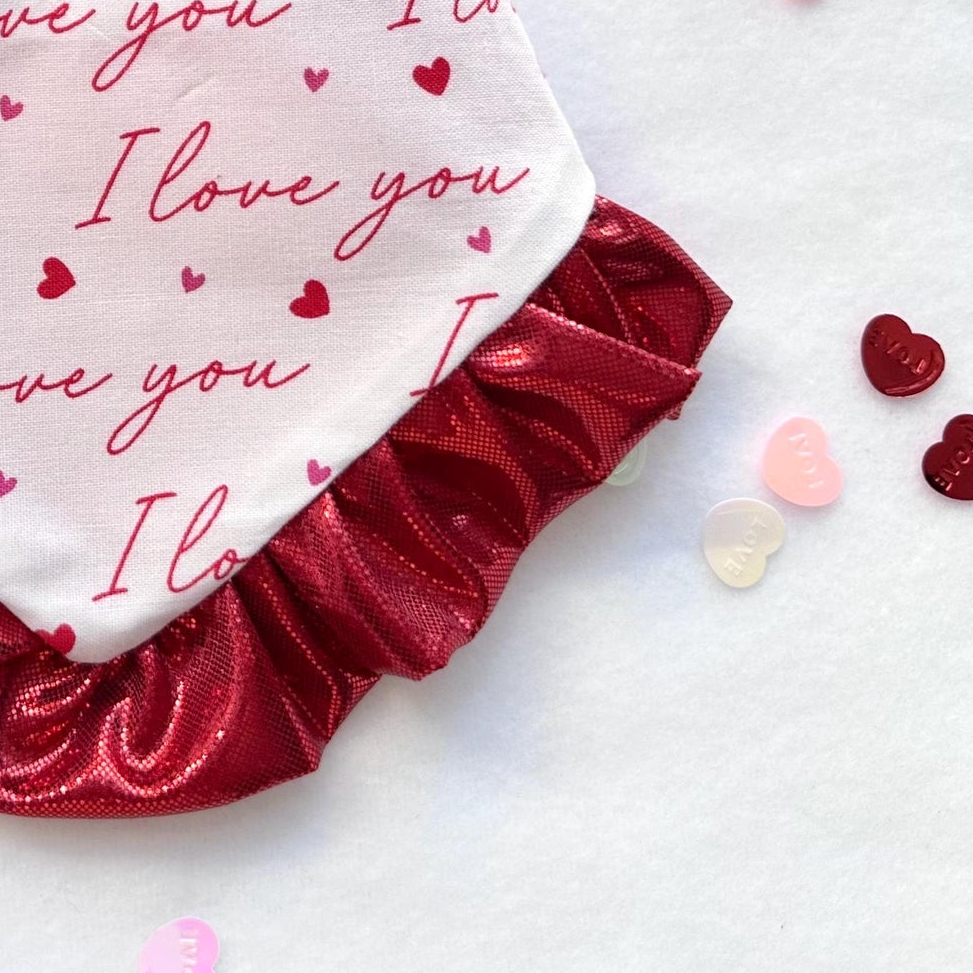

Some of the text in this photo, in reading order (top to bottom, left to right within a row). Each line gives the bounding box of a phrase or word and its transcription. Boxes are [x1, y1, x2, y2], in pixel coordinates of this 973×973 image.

[74, 120, 532, 263] I love you
[409, 291, 500, 398] I
[105, 360, 311, 457] you
[91, 484, 251, 603] I lo
[723, 514, 769, 578] LOVE
